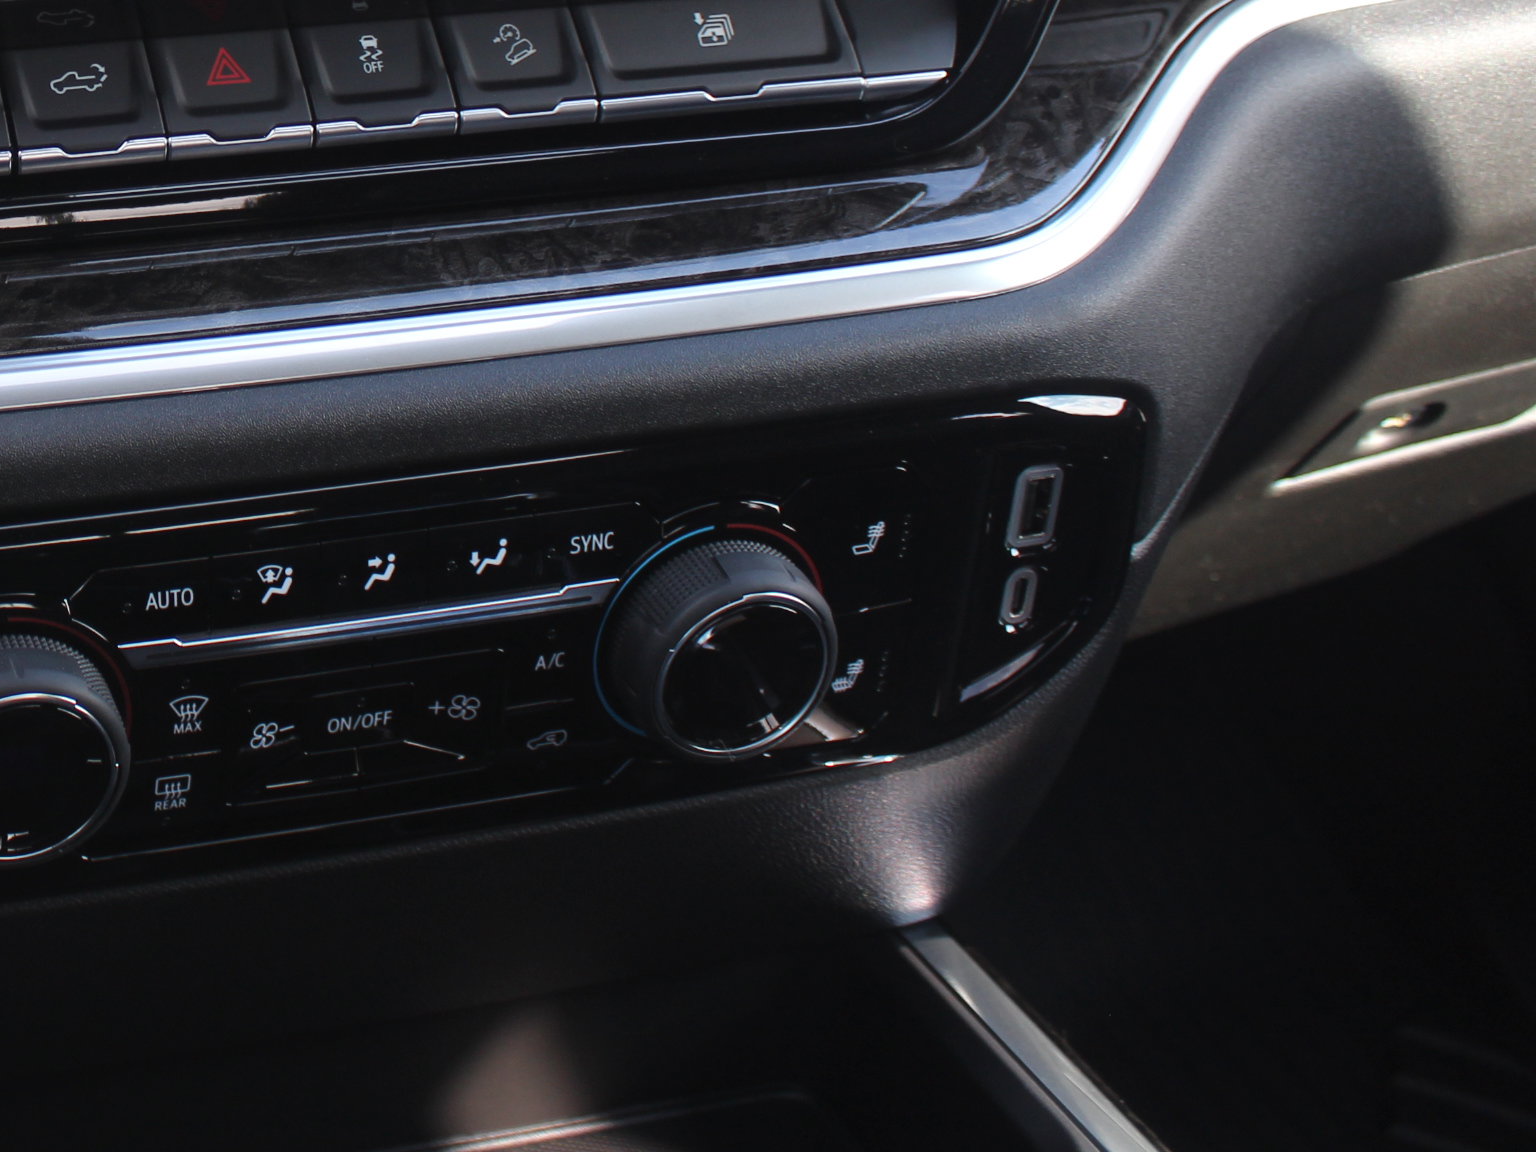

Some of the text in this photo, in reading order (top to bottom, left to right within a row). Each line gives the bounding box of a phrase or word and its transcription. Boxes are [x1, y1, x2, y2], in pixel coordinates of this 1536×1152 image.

[363, 58, 384, 74] OFF
[570, 531, 615, 554] SYNC
[146, 588, 194, 611] AUTO
[535, 652, 564, 672] A/C
[173, 718, 202, 735] MAX
[327, 709, 393, 734] ON/OFF
[154, 795, 187, 812] REAR
